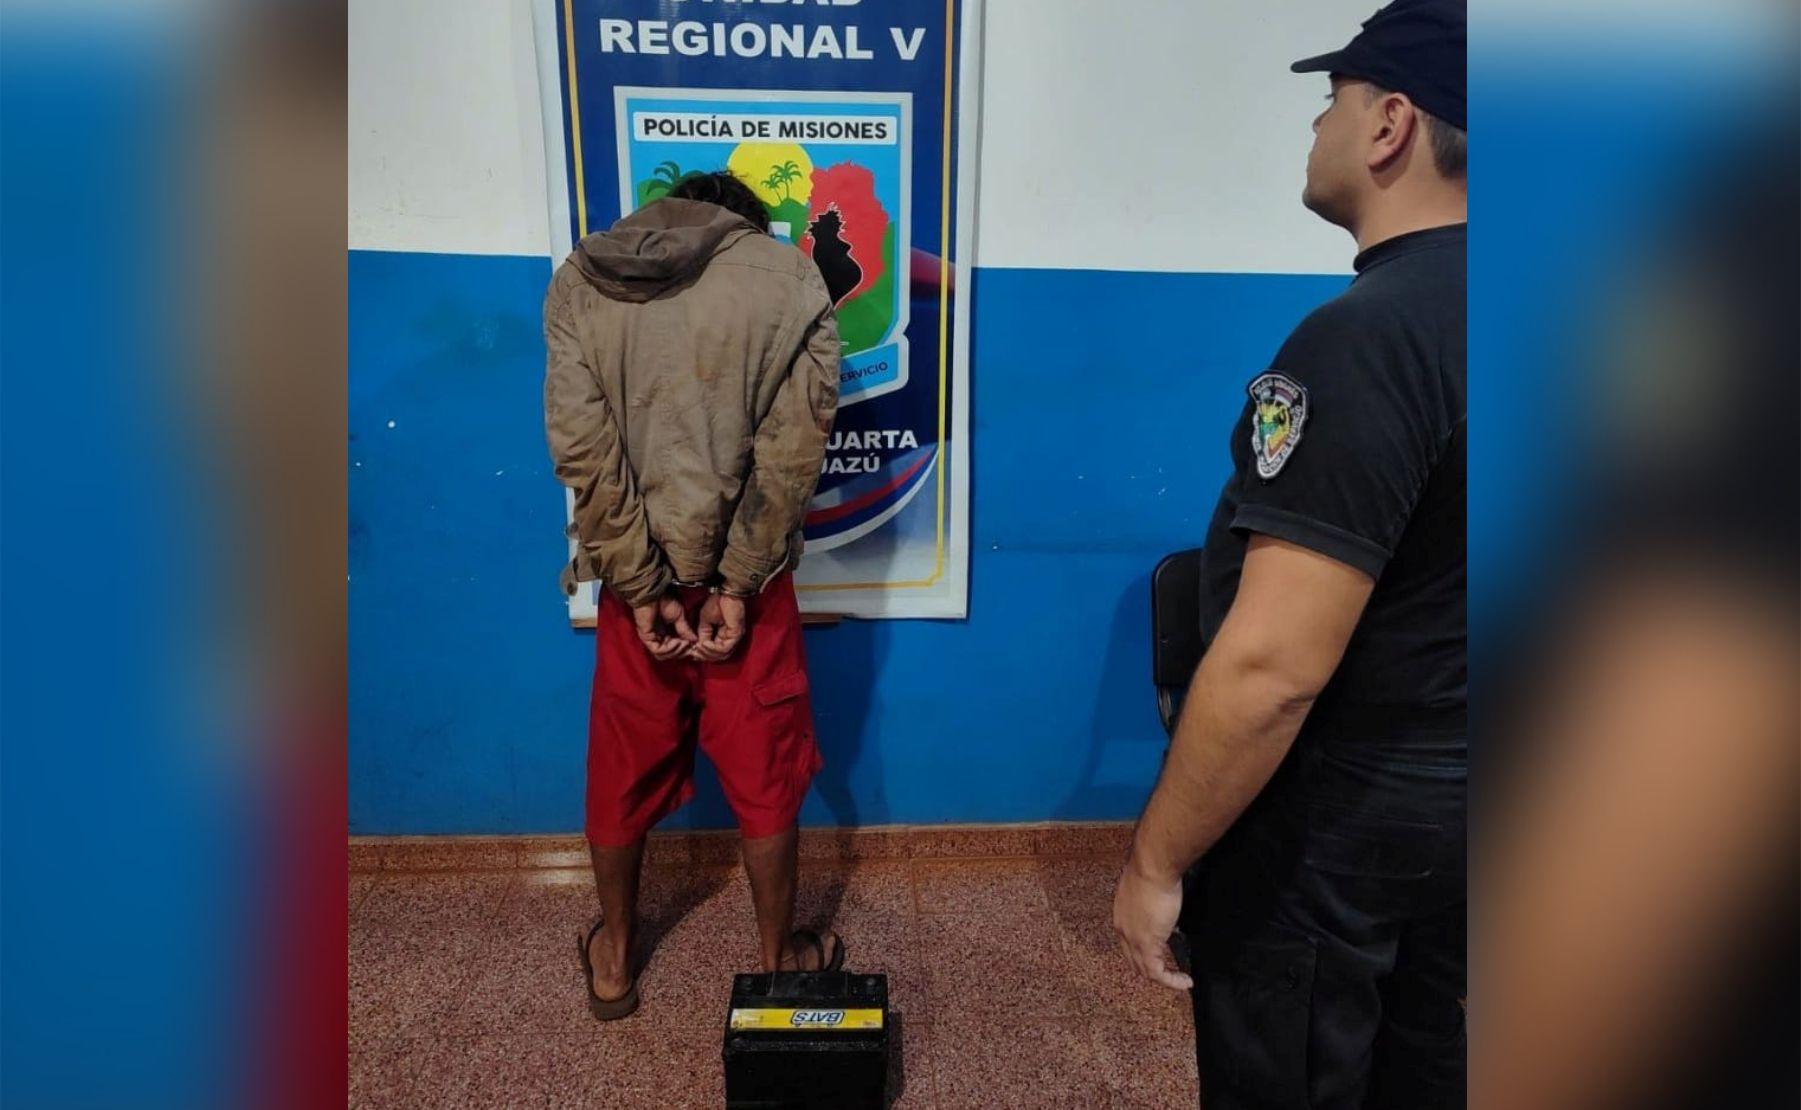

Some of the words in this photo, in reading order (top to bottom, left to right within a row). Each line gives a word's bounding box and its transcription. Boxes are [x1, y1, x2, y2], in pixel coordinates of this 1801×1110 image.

[600, 19, 874, 60] REGIONAL
[889, 27, 926, 60] V
[643, 115, 733, 139] POLICÍA
[741, 121, 769, 139] DE
[778, 121, 888, 140] MISIONES
[840, 361, 888, 383] ERVICIO
[825, 430, 918, 450] UARTA
